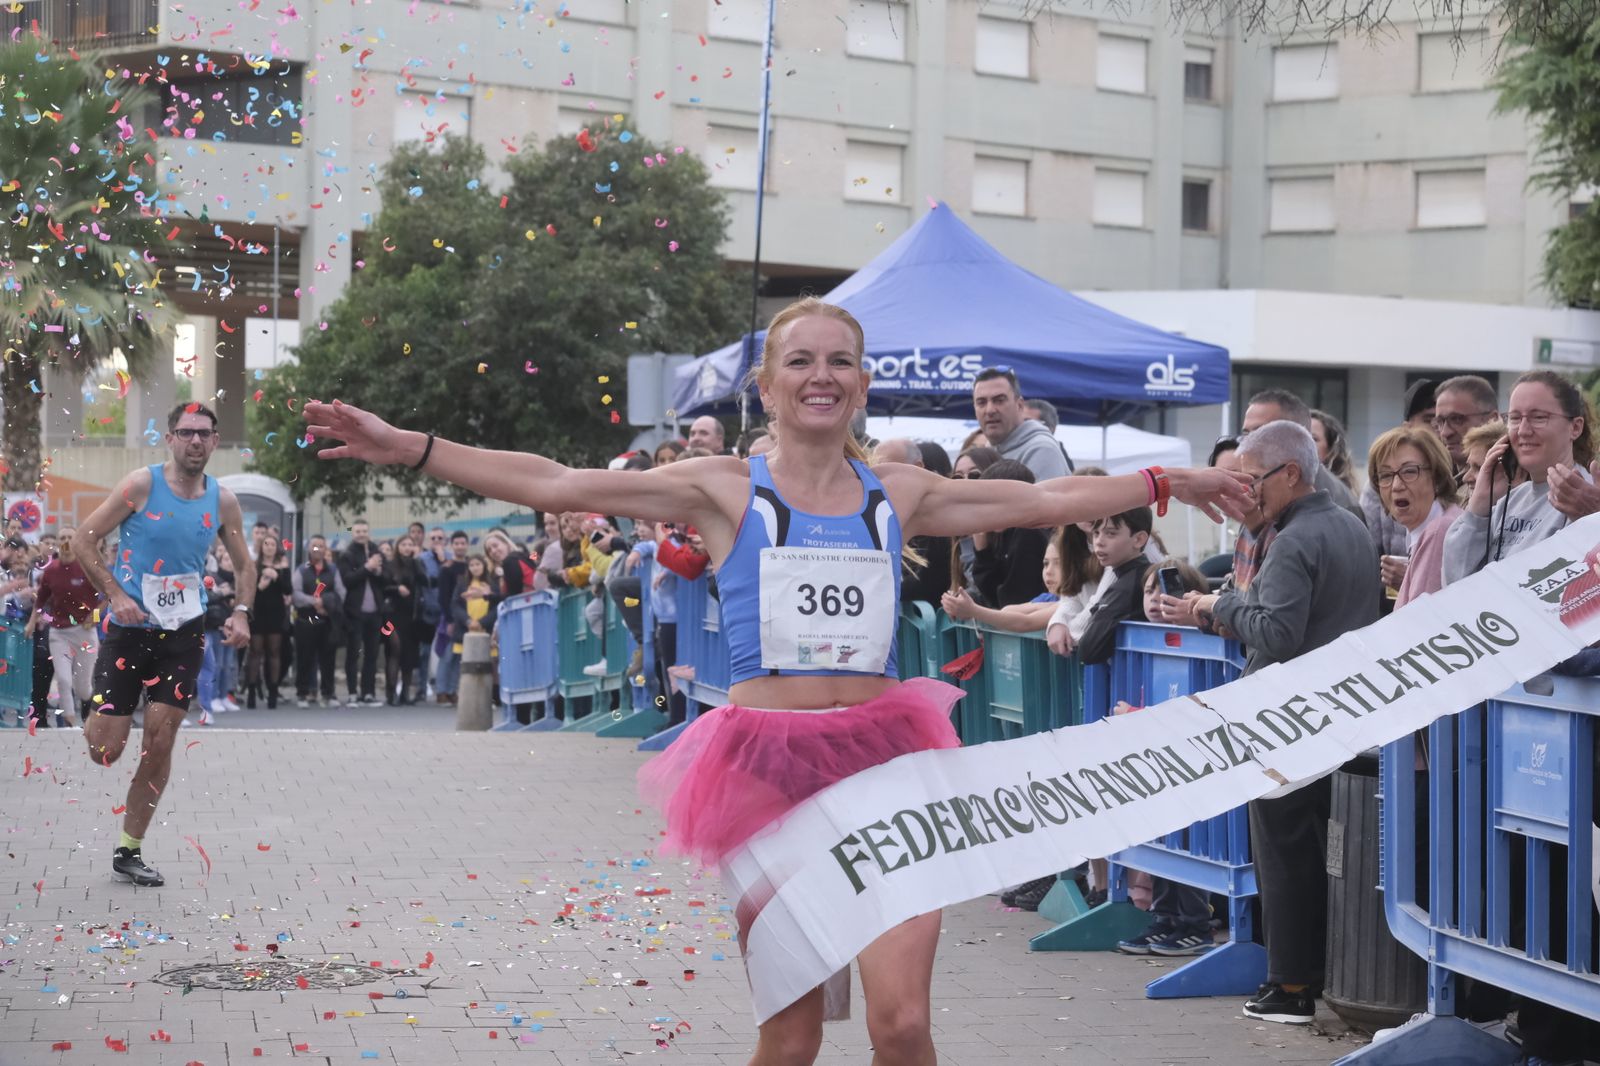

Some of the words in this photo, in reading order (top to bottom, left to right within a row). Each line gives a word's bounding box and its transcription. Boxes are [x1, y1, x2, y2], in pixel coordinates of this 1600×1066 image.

[908, 379, 934, 389] TRAIL
[802, 538, 858, 549] TROTASIERRA
[799, 554, 841, 562] SILVESTRE
[843, 555, 888, 565] CORDOBESA
[157, 589, 185, 608] 801
[797, 584, 864, 617] 369
[829, 771, 1098, 896] FEDERACIÓN
[1078, 721, 1278, 810] ANDALUZA
[1256, 694, 1333, 745] DE
